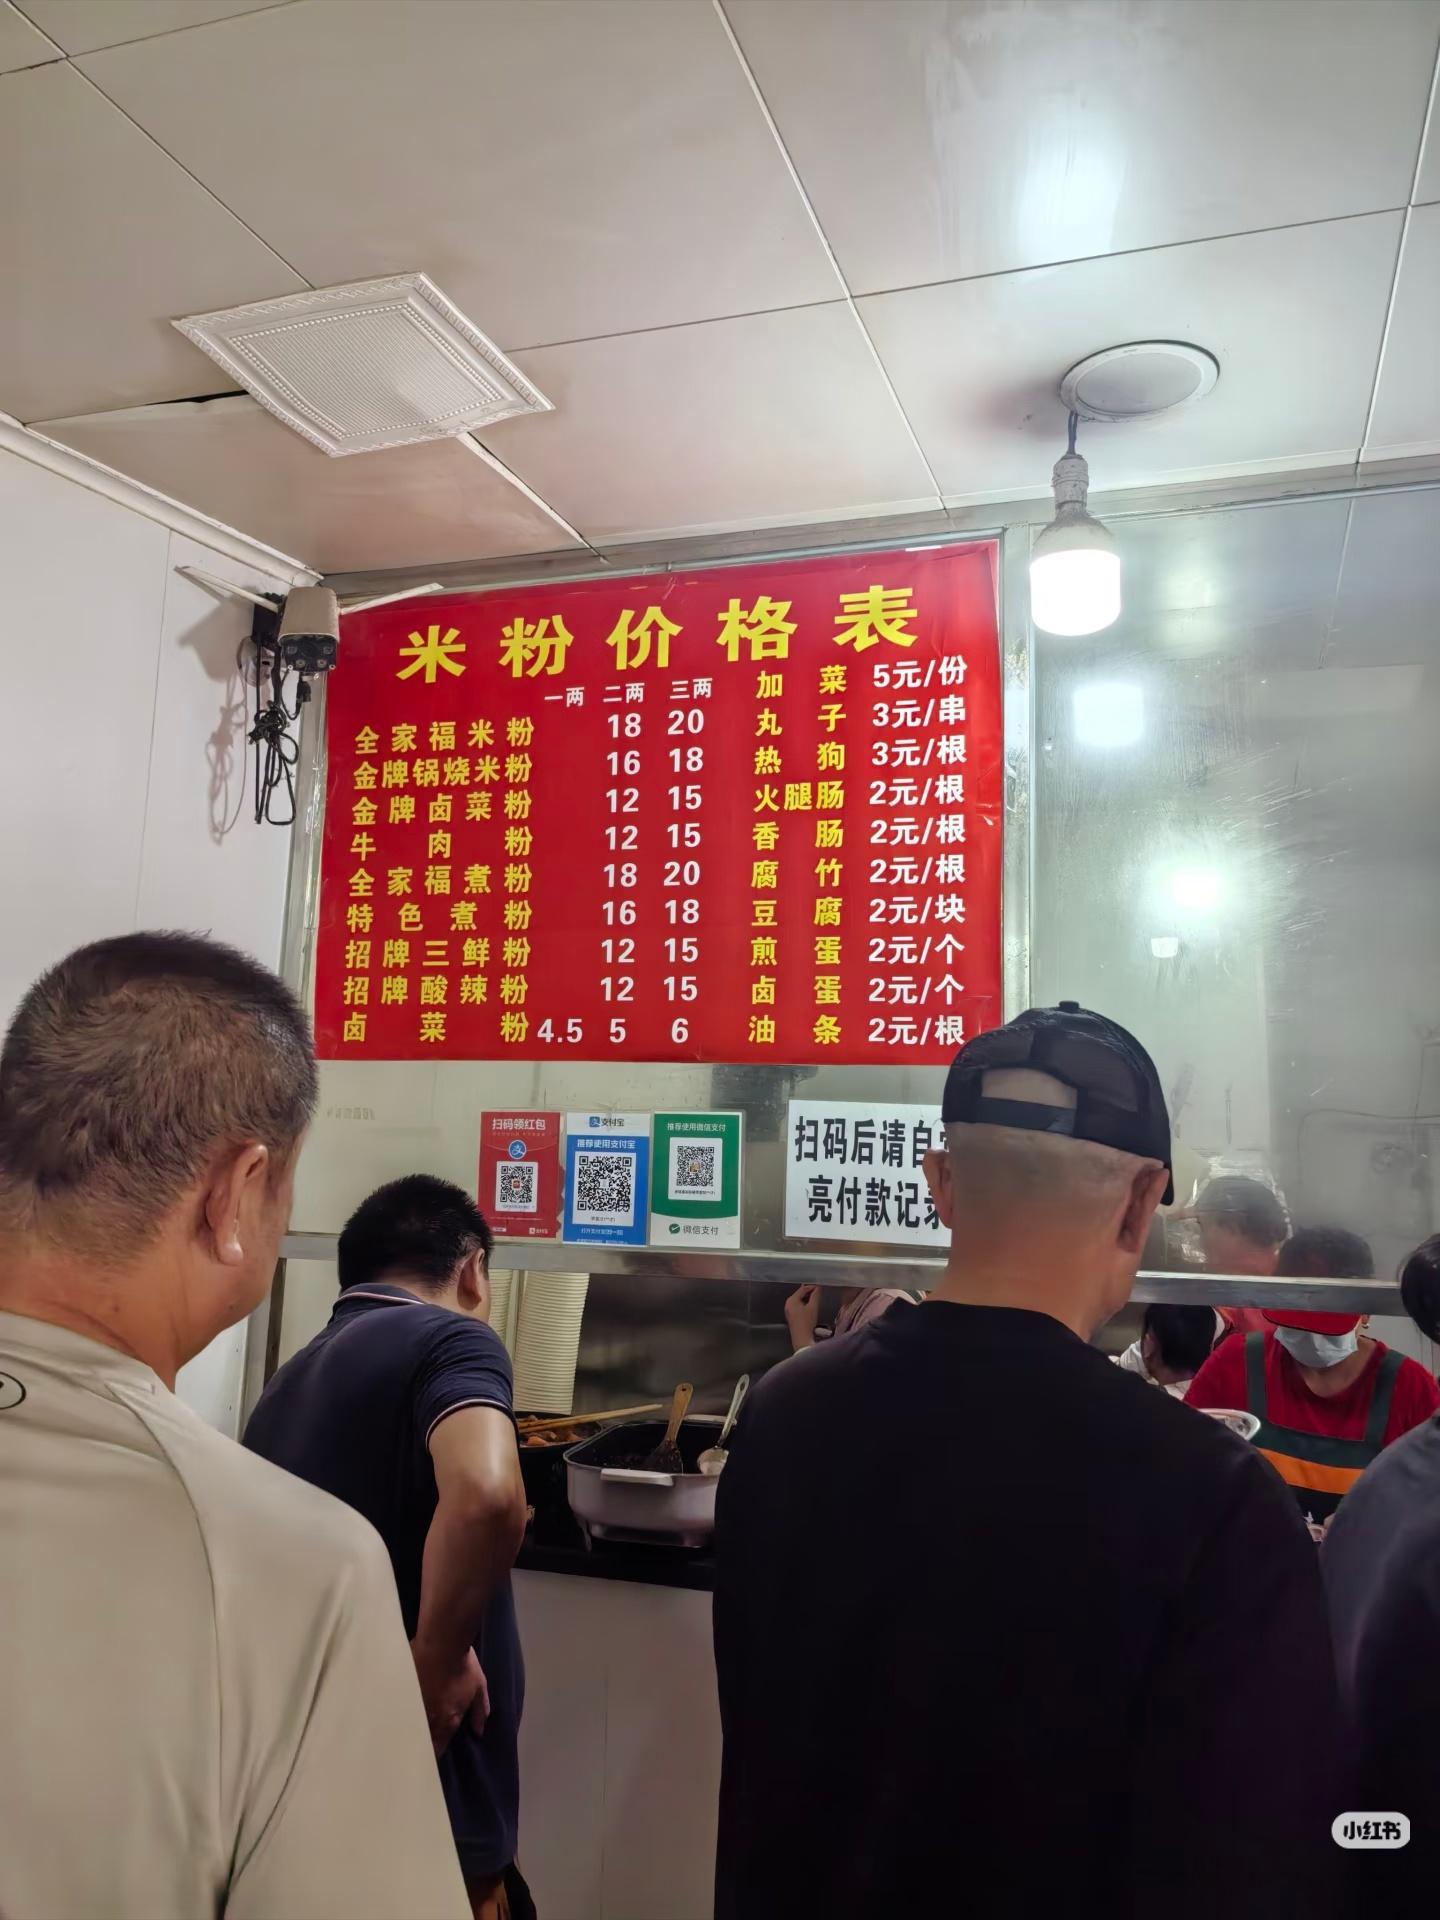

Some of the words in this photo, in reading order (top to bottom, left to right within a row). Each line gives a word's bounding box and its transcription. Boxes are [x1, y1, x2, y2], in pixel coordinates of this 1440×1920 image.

[396, 584, 919, 683] 米粉价格表
[544, 686, 584, 707] 一两
[603, 682, 645, 703] 二两
[669, 677, 713, 699] 三两
[755, 664, 848, 699] 加菜
[873, 654, 968, 690] 5元/份
[355, 716, 534, 754] 全家福米粉
[607, 712, 641, 738] 18
[667, 708, 704, 735] 20
[754, 703, 847, 737] 丸子
[872, 694, 966, 729] 3元/串
[353, 753, 532, 790] 金牌锅烧米粉
[607, 750, 641, 776] 16
[669, 746, 704, 773] 18
[754, 741, 846, 775] 热狗
[871, 734, 968, 768] 3元/根
[351, 789, 532, 825] 金牌卤菜粉
[606, 787, 639, 813] 12
[668, 784, 702, 810] 15
[753, 780, 845, 813] 火腿肠
[869, 774, 965, 807] 2元/根
[350, 826, 533, 861] 牛肉粉
[605, 825, 638, 850] 12
[667, 822, 701, 848] 15
[752, 819, 844, 851] 香肠
[870, 814, 966, 846] 2元/根
[348, 863, 533, 897] 全家福煮粉
[603, 862, 637, 888] 18
[663, 860, 701, 886] 20
[751, 857, 844, 889] 腐竹
[869, 853, 966, 885] 2元/根
[346, 900, 533, 933] 特色煮粉
[602, 900, 636, 925] 16
[665, 898, 699, 924] 18
[751, 896, 843, 927] 豆腐
[869, 893, 966, 925] 2元/块
[345, 937, 531, 969] 招牌三鲜粉
[601, 938, 635, 963] 12
[664, 937, 699, 963] 15
[750, 936, 843, 966] 煎蛋
[868, 933, 965, 965] 2元/个
[343, 974, 528, 1005] 招牌酸辣粉
[600, 976, 634, 1001] 12
[663, 976, 698, 1001] 15
[751, 975, 842, 1005] 卤蛋
[868, 973, 965, 1005] 2元/个
[343, 1011, 529, 1042] 卤菜粉
[537, 1018, 583, 1043] 4.5
[609, 1018, 626, 1043] 5
[671, 1017, 689, 1044] 6
[748, 1014, 842, 1045] 油条
[868, 1014, 966, 1046] 2元/根
[492, 1118, 547, 1131] 扫码领红包
[601, 1117, 625, 1127] 支付宝
[667, 1122, 727, 1133] 推荐使用微信支付
[577, 1138, 636, 1149] 推荐使用支付宝
[682, 1225, 719, 1236] 微信支付
